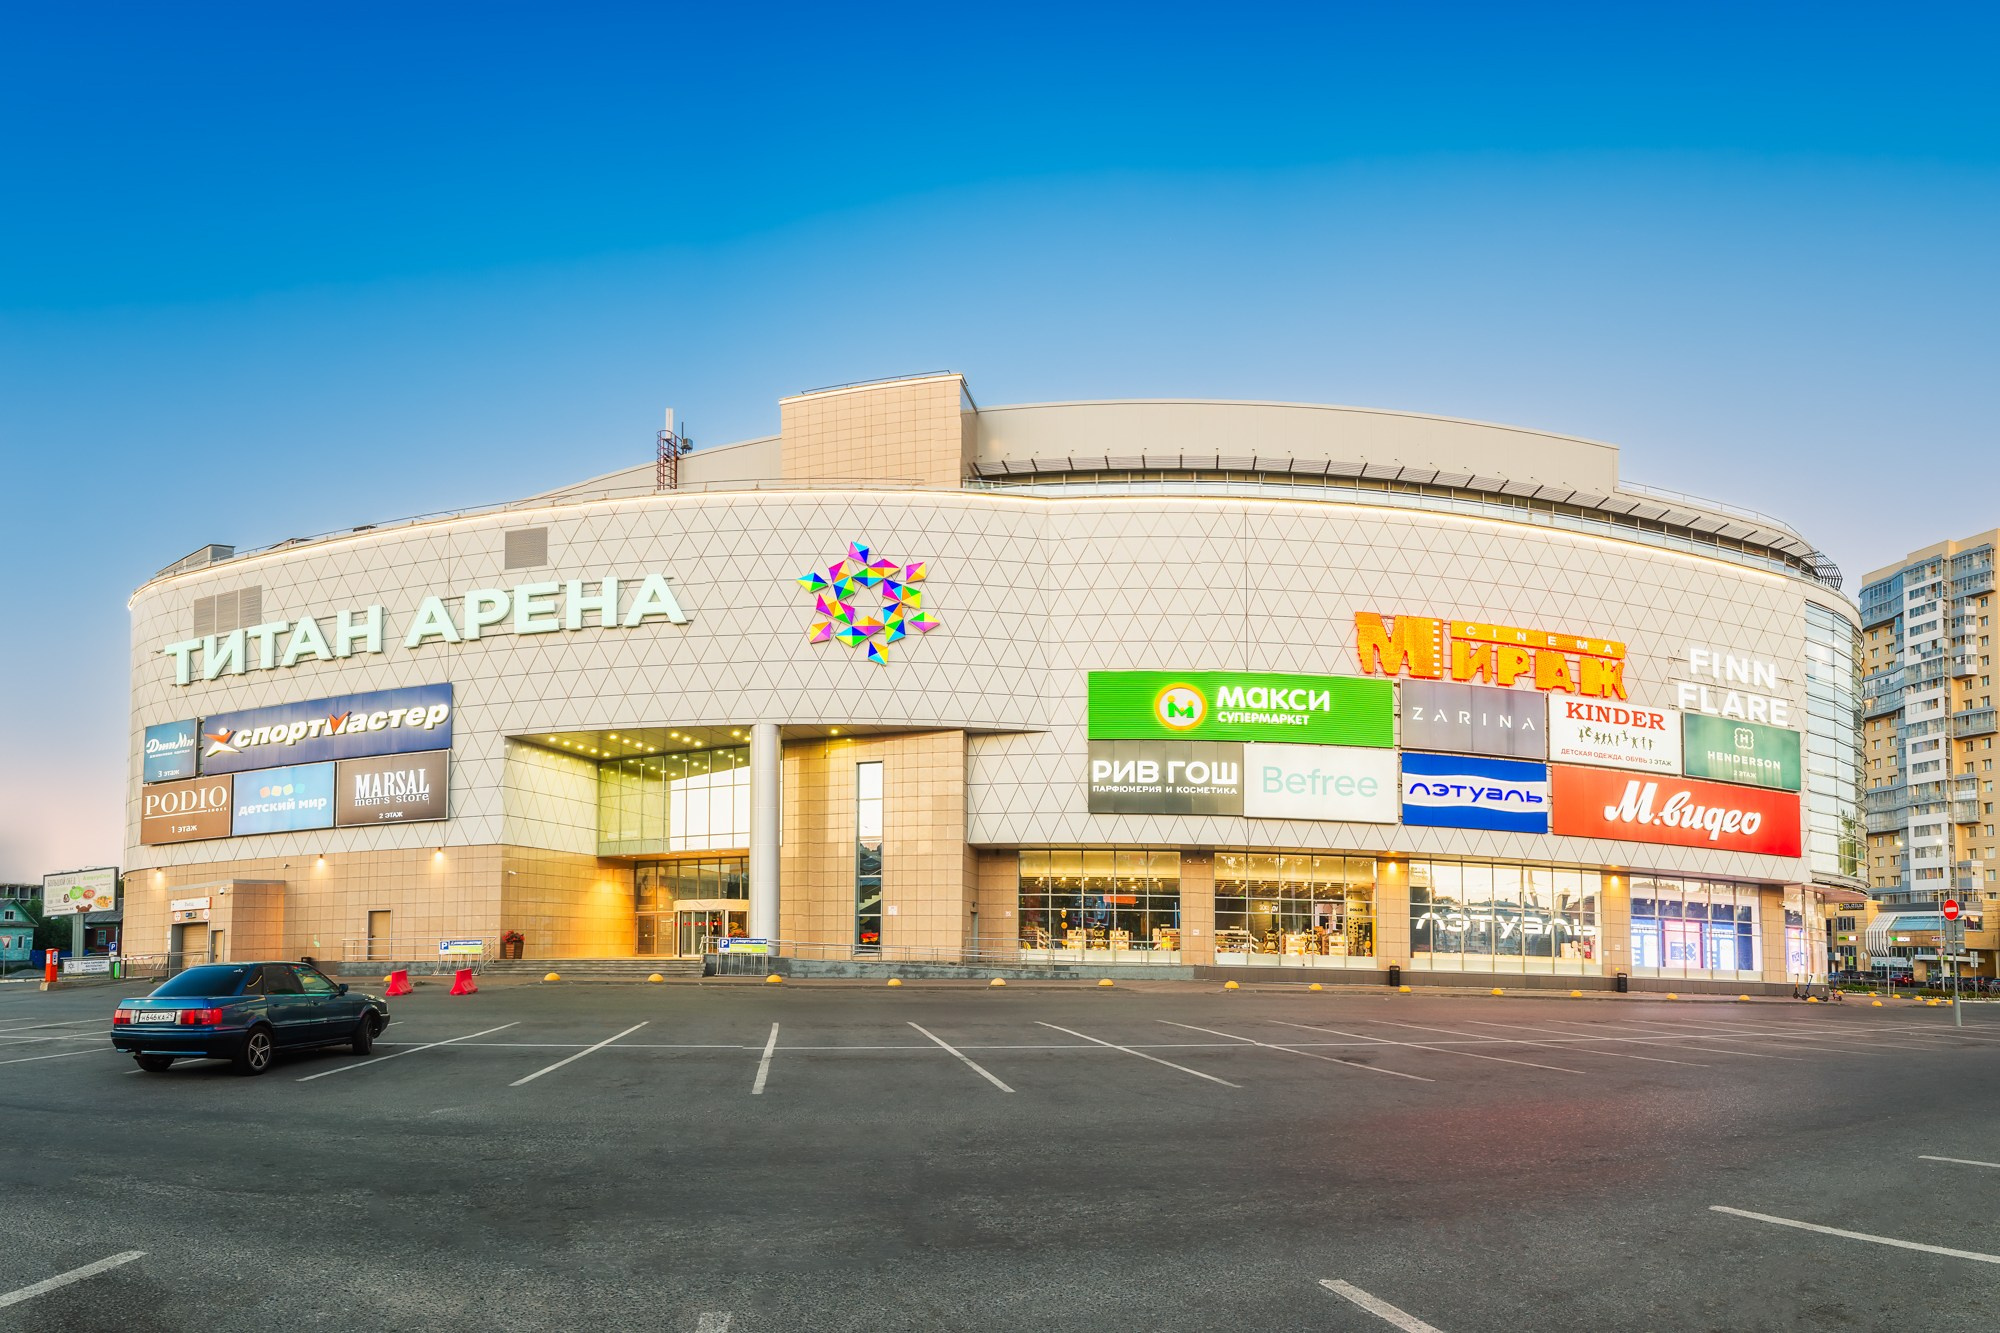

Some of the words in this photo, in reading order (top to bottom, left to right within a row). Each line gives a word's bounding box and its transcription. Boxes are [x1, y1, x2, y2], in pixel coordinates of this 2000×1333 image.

[165, 605, 384, 686] ТИТАН
[404, 573, 688, 648] АРЕНА
[1465, 626, 1613, 653] CINEMA
[1355, 611, 1628, 699] МИРАЖ
[1689, 648, 1776, 689] FINN
[1217, 711, 1309, 725] СУПЕРМАРКЕТ
[1565, 701, 1666, 731] KINDER
[1677, 683, 1788, 727] FLARE
[233, 703, 450, 746] спортмастер
[1412, 706, 1536, 731] ZARINA
[1560, 748, 1592, 757] ДЕТСКАЯ
[1625, 755, 1648, 763] ОБУВЬ
[1707, 750, 1781, 770] HENDERSON
[354, 768, 430, 799] MARSAL
[1092, 760, 1159, 783] РИВ
[1168, 760, 1238, 785] ГОШ
[1262, 765, 1379, 798] Befree
[1739, 770, 1757, 779] ЭТАЖ
[144, 785, 228, 815] PODIO
[354, 796, 390, 807] men's
[395, 792, 430, 804] store
[1092, 785, 1162, 793] ПАРФЮМЕРИЯ
[1166, 785, 1173, 793] И
[1176, 785, 1238, 795] КОСМЕТИКА
[238, 799, 295, 816] детский
[298, 798, 328, 812] мир
[171, 825, 175, 833] 1
[177, 825, 198, 833] этаж
